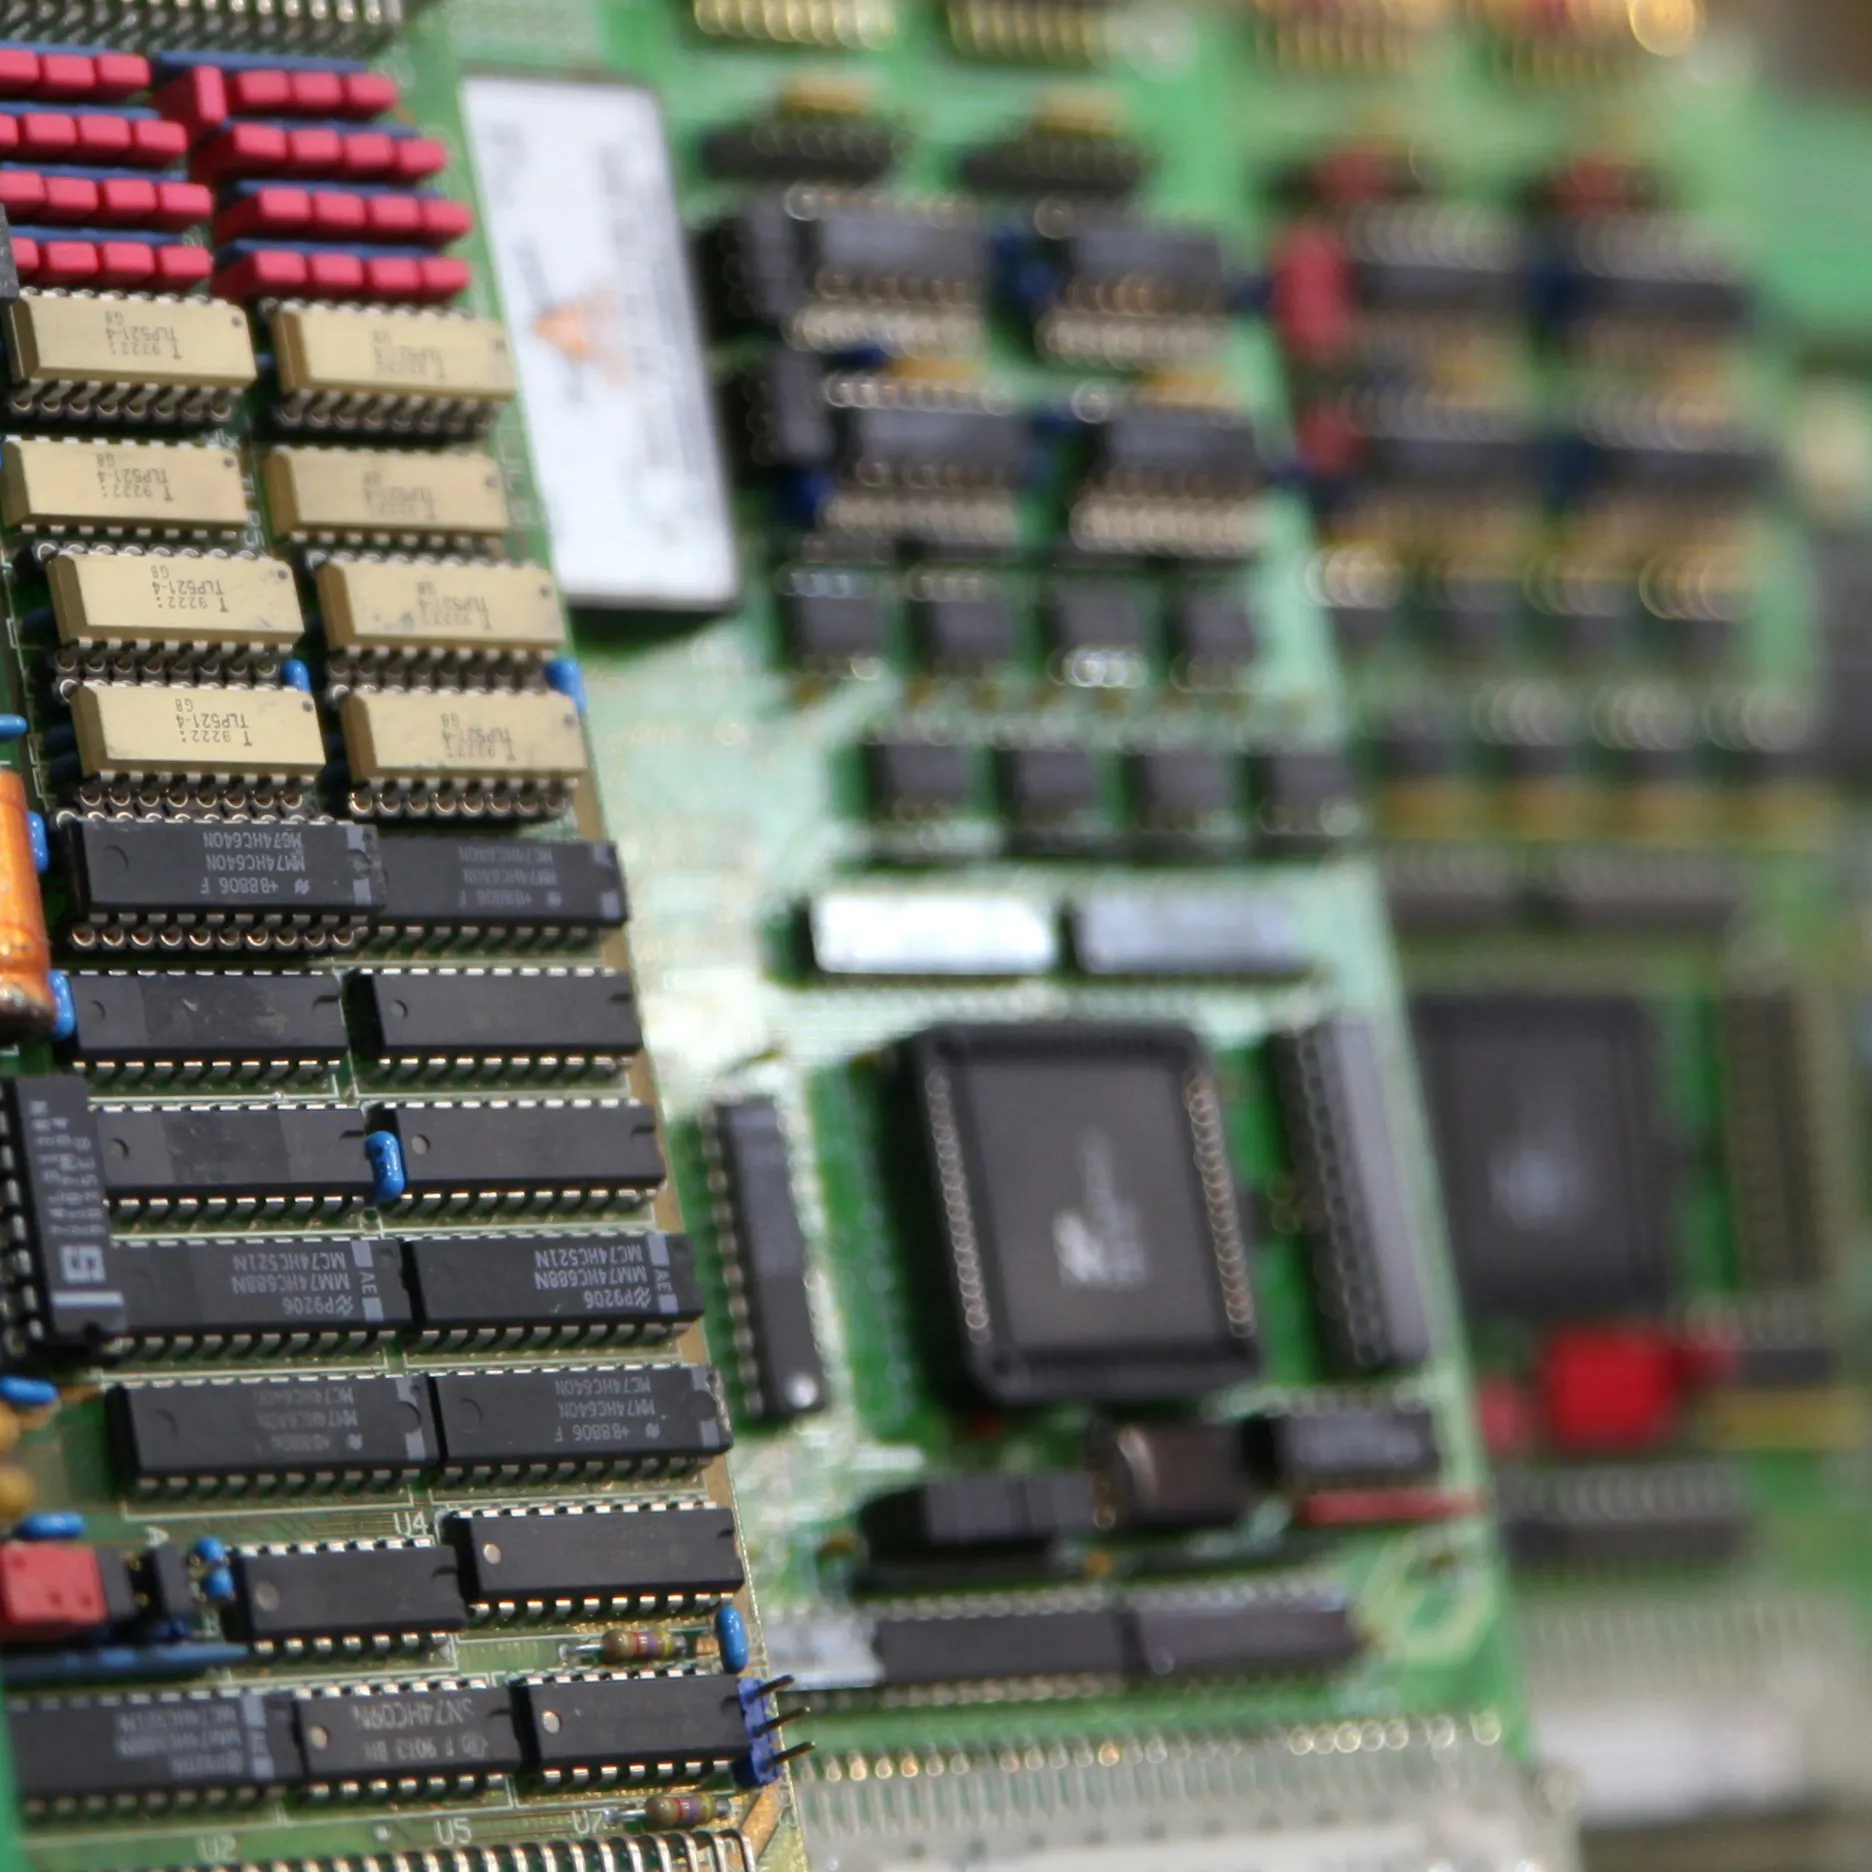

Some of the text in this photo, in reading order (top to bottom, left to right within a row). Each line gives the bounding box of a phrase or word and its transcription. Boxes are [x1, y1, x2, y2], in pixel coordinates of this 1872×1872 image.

[96, 467, 169, 485] TLP521-4
[150, 579, 225, 596] TLP521-4
[174, 712, 249, 729] TLP521-4
[205, 854, 307, 872] MM74HC640N
[199, 876, 210, 896] F
[232, 1251, 347, 1272] MC74HC521N
[534, 1243, 644, 1268] MC74HC521N
[534, 1265, 648, 1290] MM74HC688N
[583, 1288, 634, 1309] P9206
[554, 1425, 565, 1443] F
[392, 1510, 429, 1538] U4
[434, 1817, 472, 1846] U5
